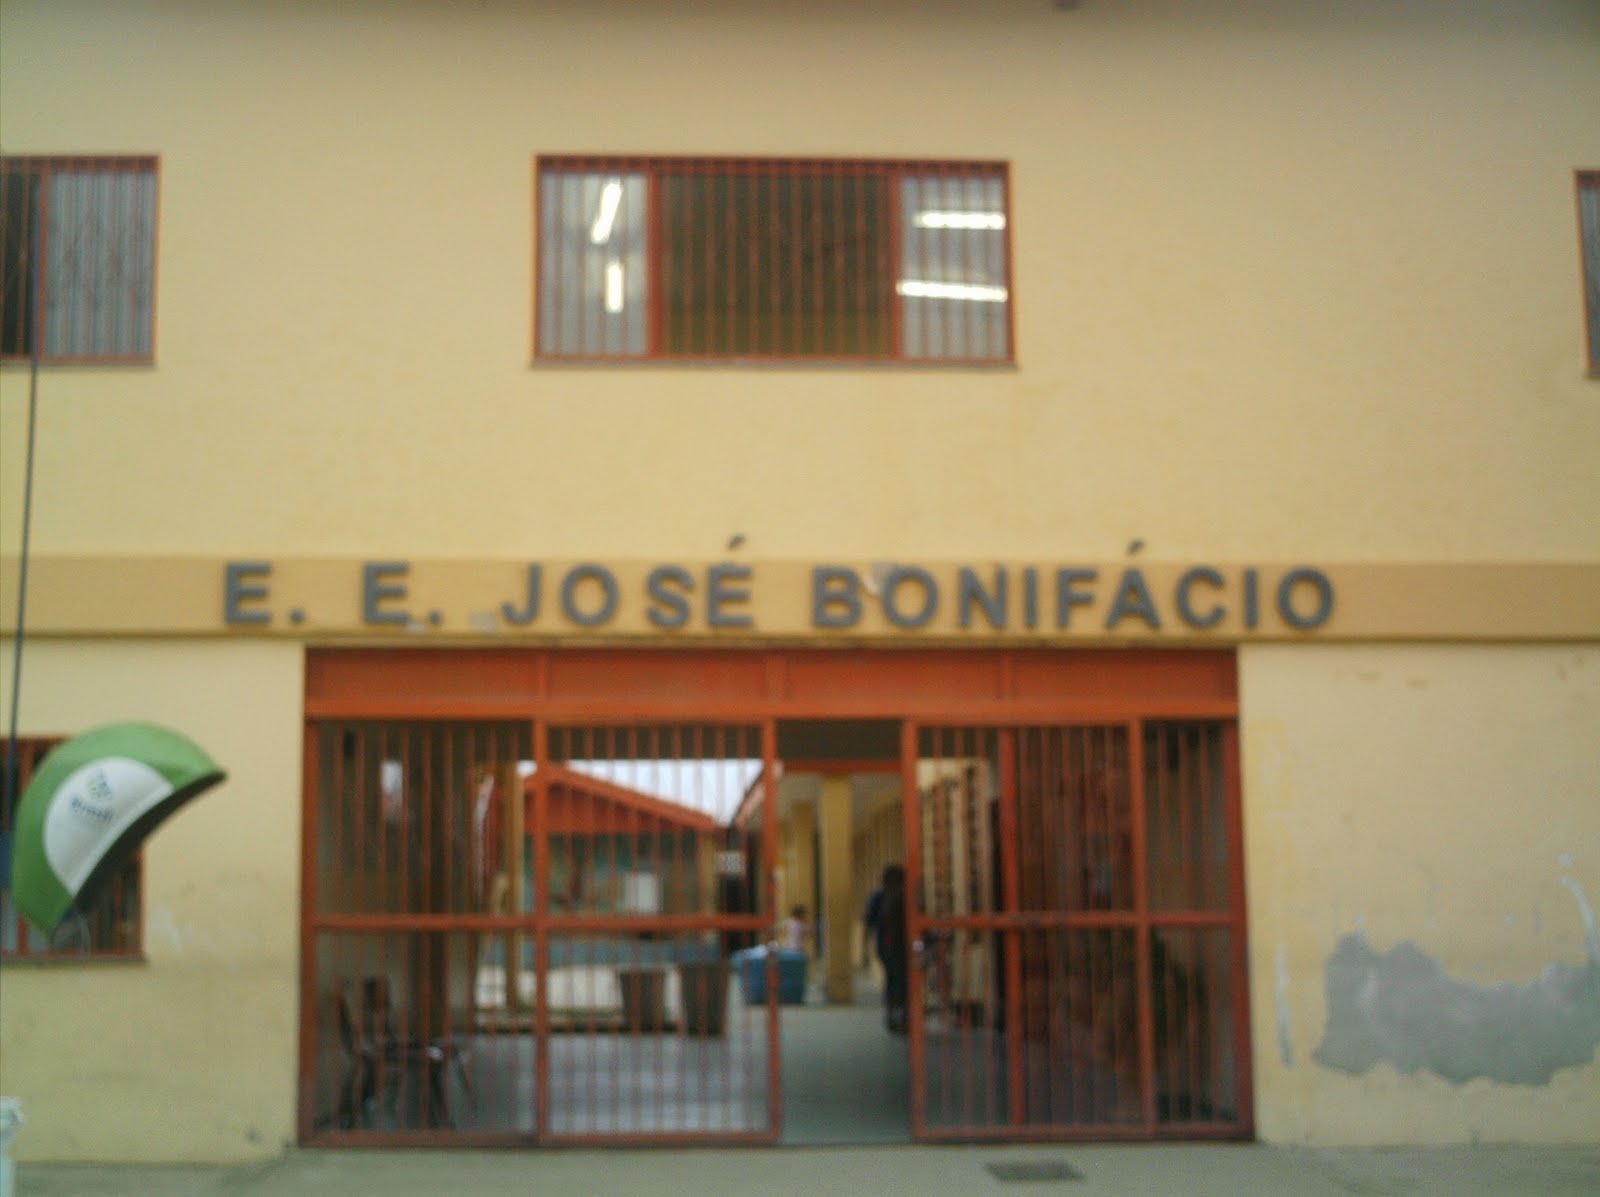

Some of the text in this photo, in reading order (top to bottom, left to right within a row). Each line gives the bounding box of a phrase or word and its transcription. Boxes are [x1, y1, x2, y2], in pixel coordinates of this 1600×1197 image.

[224, 534, 1335, 630] E. E. JOSÉ BONIFÁCIO
